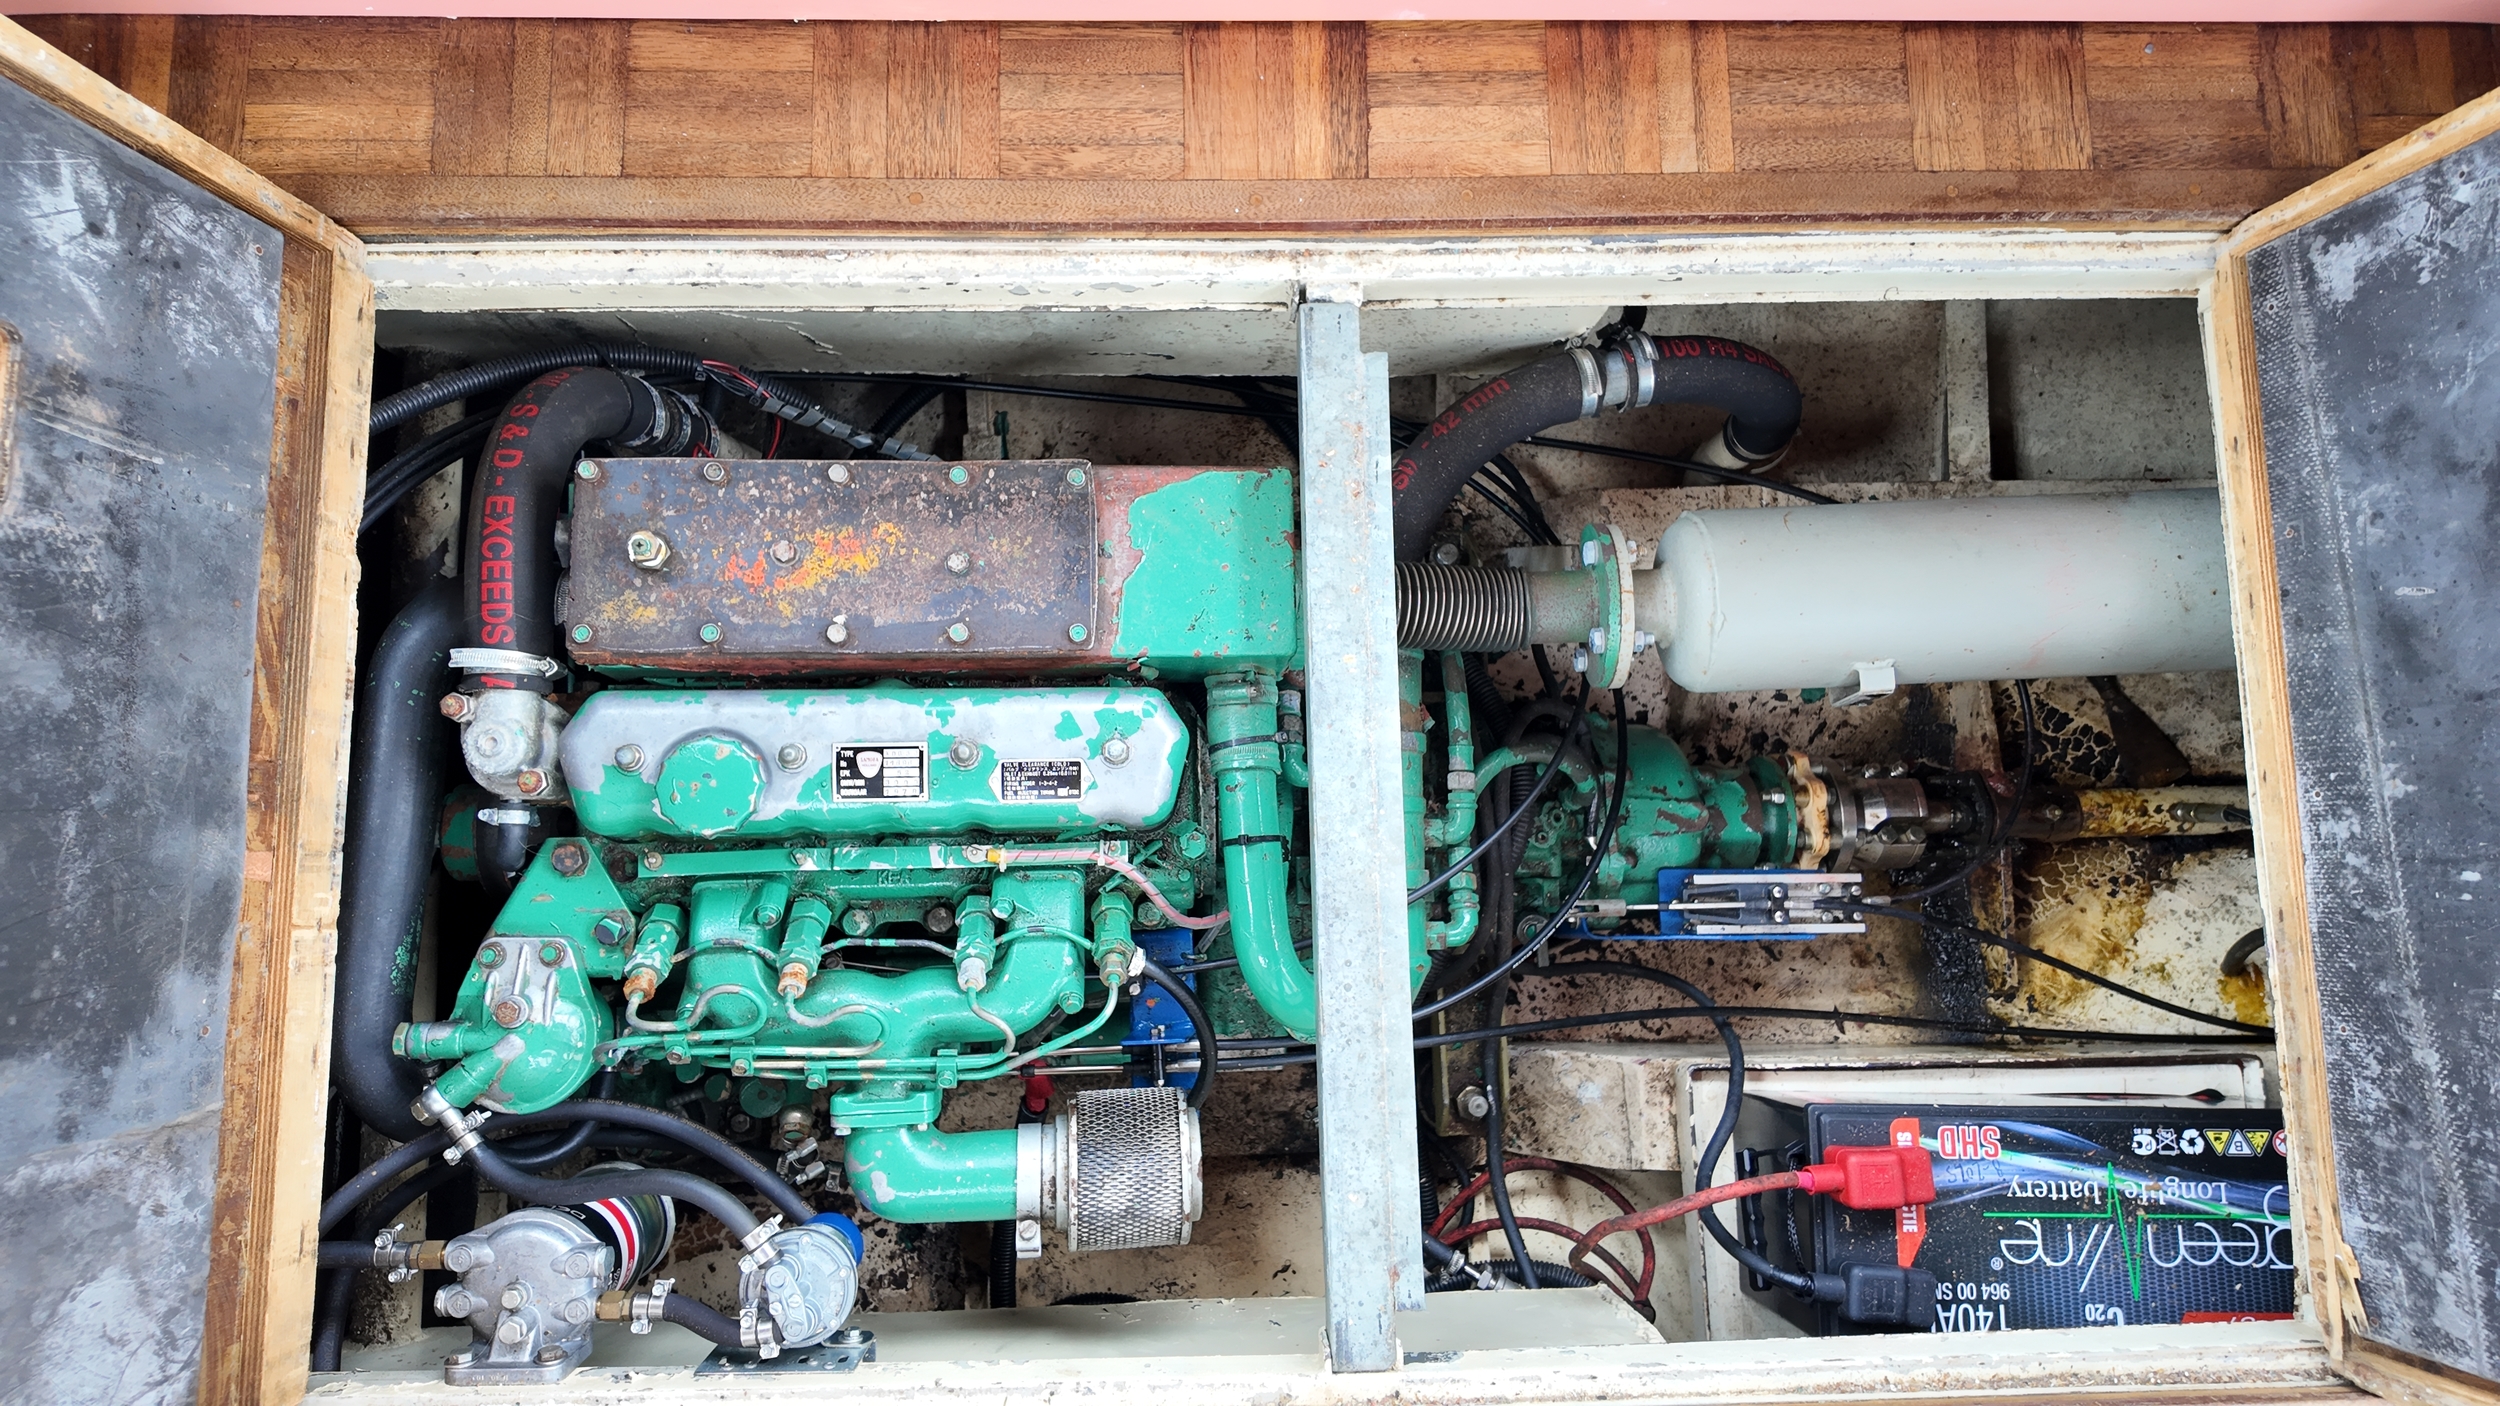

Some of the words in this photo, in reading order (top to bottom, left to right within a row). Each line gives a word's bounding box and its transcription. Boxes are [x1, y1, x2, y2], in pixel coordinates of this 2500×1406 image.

[1657, 339, 1701, 358] 100
[1707, 339, 1739, 358] R4
[509, 403, 540, 418] S
[1432, 410, 1462, 438] 42
[1462, 378, 1511, 413] mm
[493, 449, 523, 468] D
[480, 495, 515, 645] EXCEEDS
[1937, 1125, 2002, 1160] SHD
[2006, 1174, 2102, 1205] battery
[1957, 1282, 1977, 1300] 00
[1981, 1282, 2011, 1300] 964
[1932, 1303, 2011, 1333] 140A
